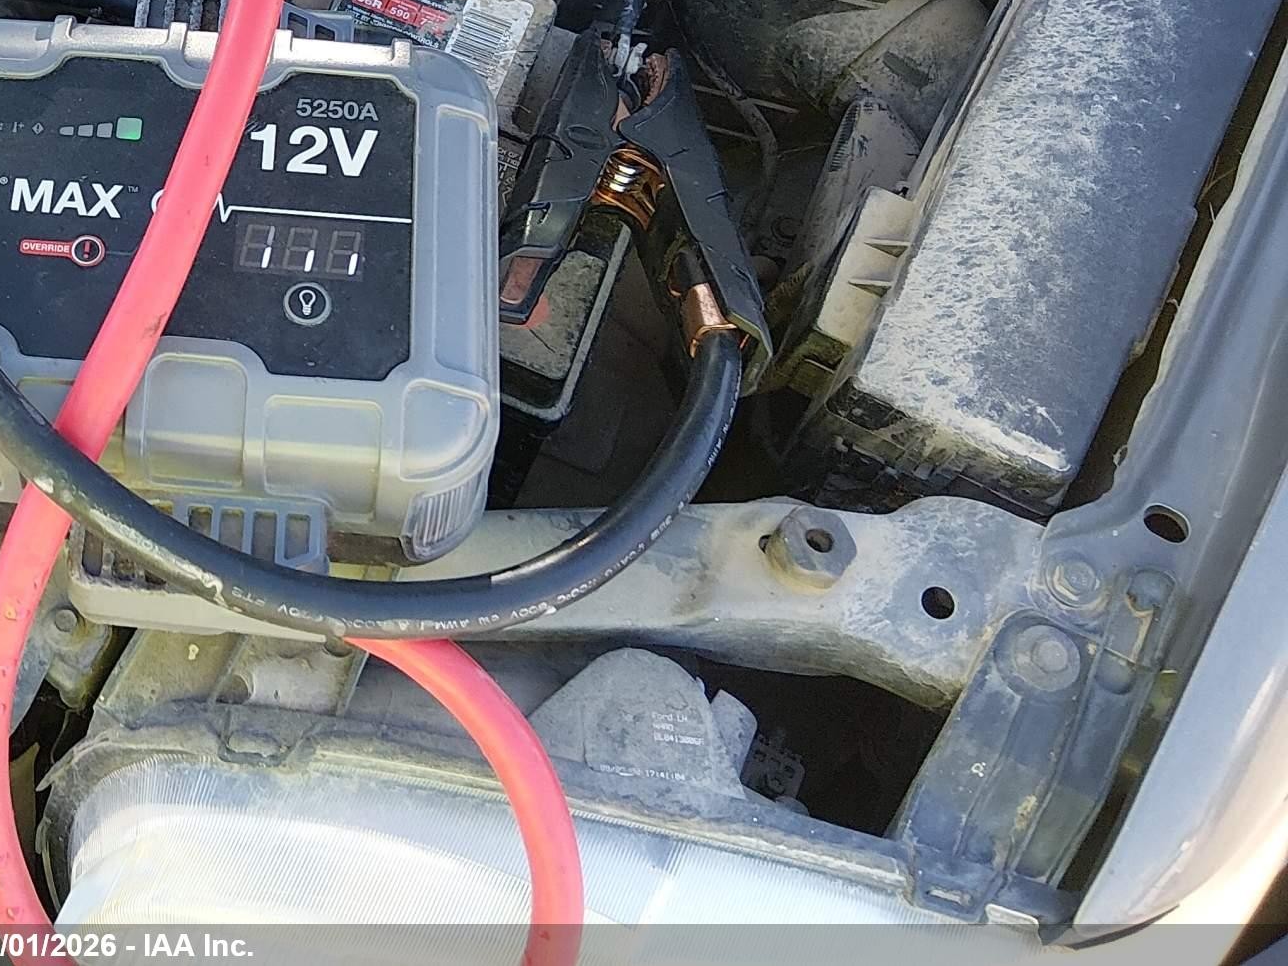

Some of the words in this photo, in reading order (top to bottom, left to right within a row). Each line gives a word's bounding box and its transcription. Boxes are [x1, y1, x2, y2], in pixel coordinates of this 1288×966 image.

[389, 6, 411, 20] 590
[296, 98, 379, 121] 5250A
[250, 124, 379, 177] 12V
[22, 241, 70, 253] OVERRIDE
